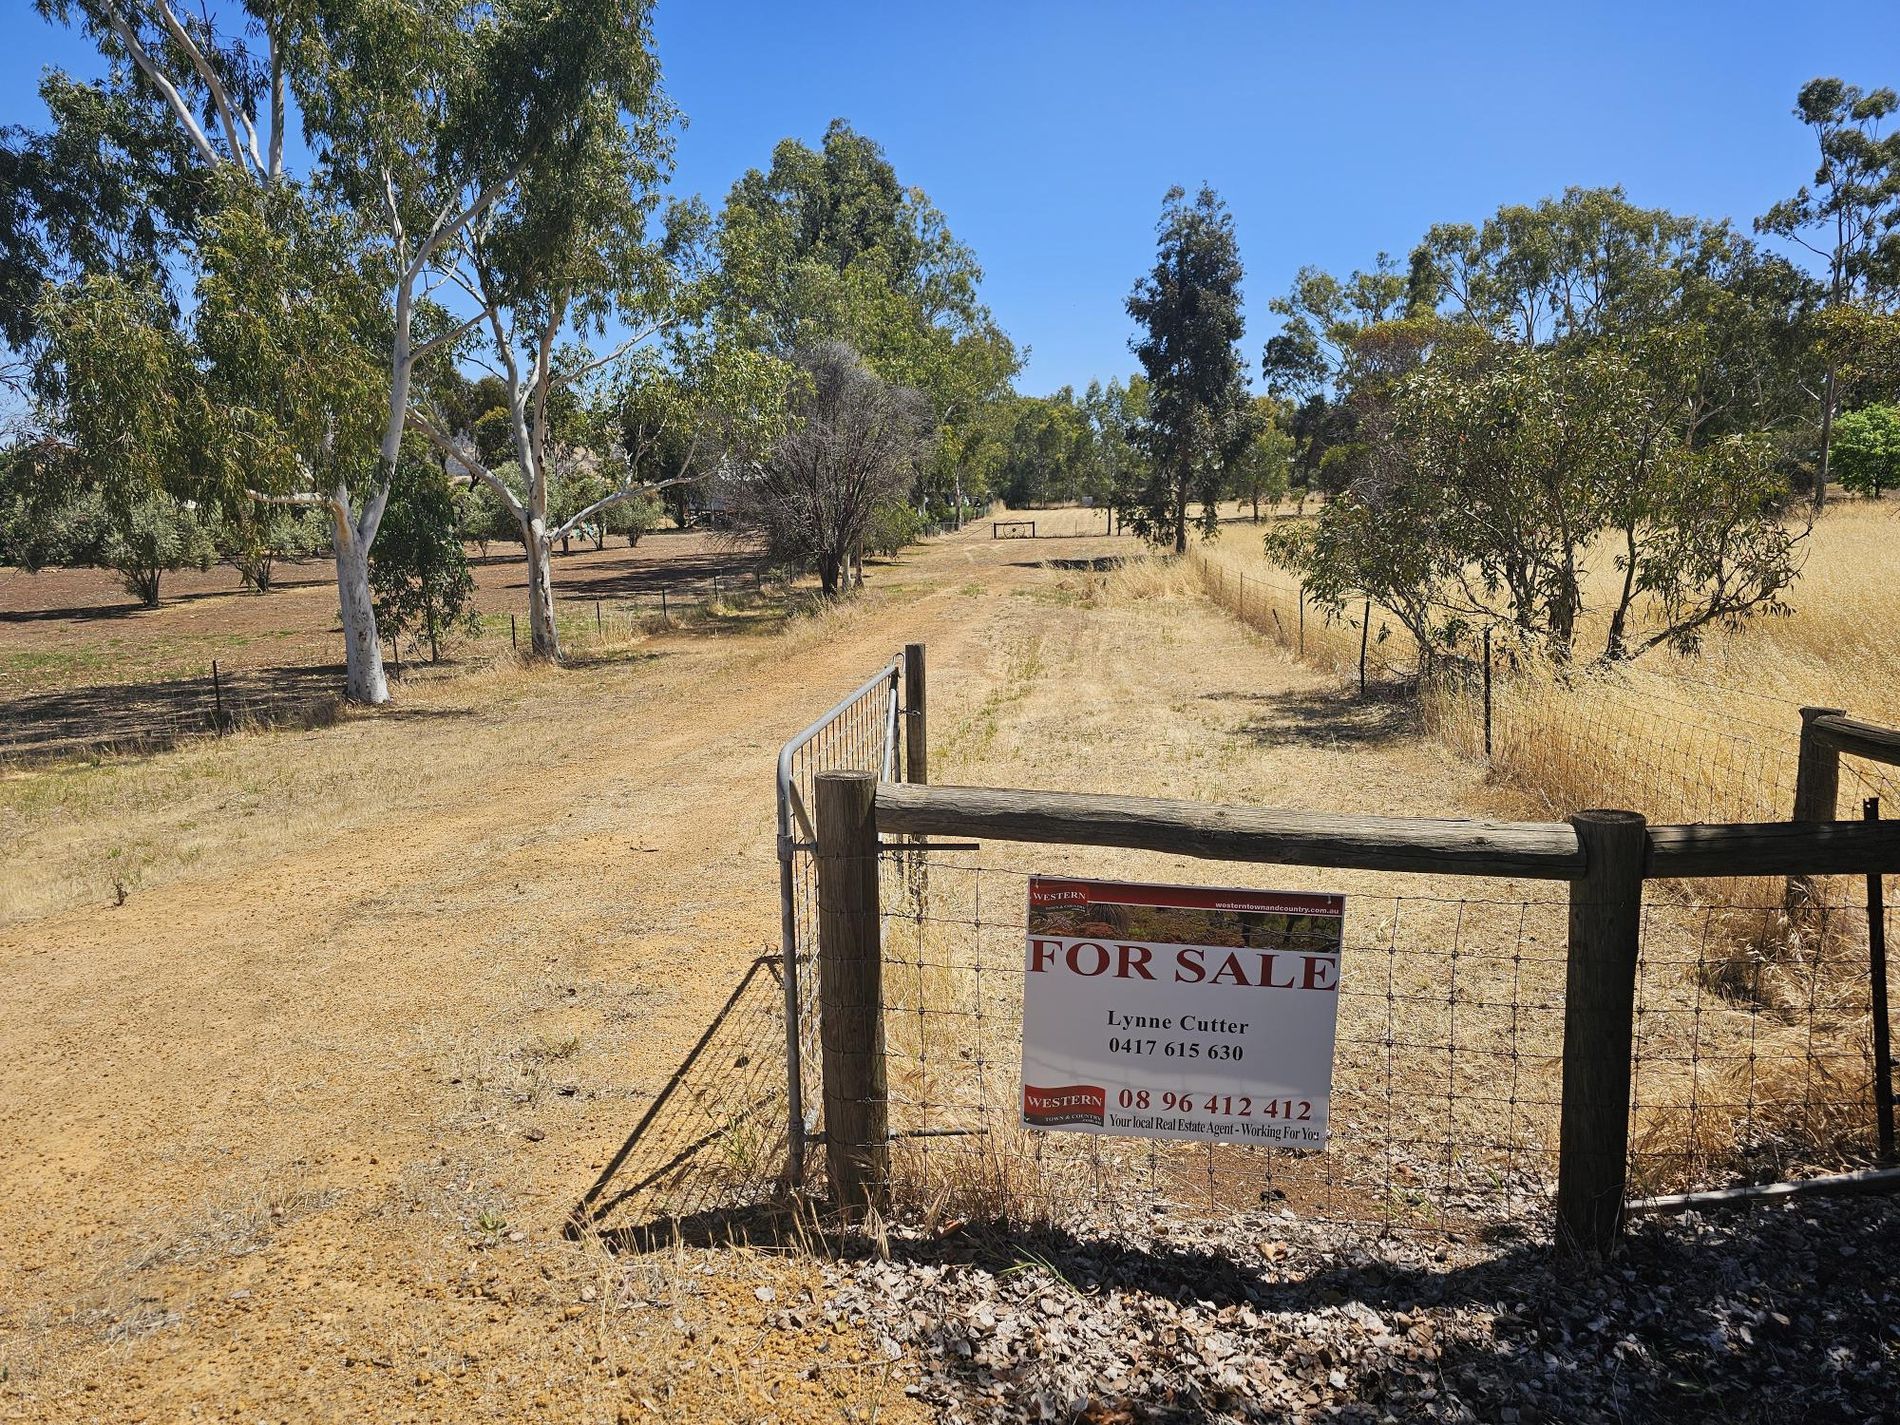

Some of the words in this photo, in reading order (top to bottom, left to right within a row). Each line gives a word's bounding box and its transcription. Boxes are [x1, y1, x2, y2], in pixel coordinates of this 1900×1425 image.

[1033, 891, 1086, 901] WESTERN
[1215, 902, 1339, 914] westerntownandcountry.com.au
[1026, 939, 1157, 981] FOR
[1175, 948, 1337, 991] SALE
[1106, 1010, 1172, 1031] Lynne
[1180, 1015, 1249, 1034] Cutter
[1109, 1037, 1157, 1055] 0417
[1164, 1041, 1200, 1058] 615
[1207, 1045, 1243, 1061] 630
[1027, 1094, 1103, 1108] WESTERN
[1119, 1088, 1150, 1109] 08
[1161, 1092, 1194, 1112] 96
[1203, 1095, 1252, 1116] 412
[1263, 1099, 1311, 1120] 412
[1110, 1113, 1132, 1128] Your
[1133, 1115, 1154, 1130] local
[1156, 1116, 1175, 1131] Real
[1178, 1118, 1205, 1133] Estate
[1206, 1120, 1233, 1137] Agent
[1241, 1123, 1281, 1142] Working
[1283, 1126, 1300, 1140] For
